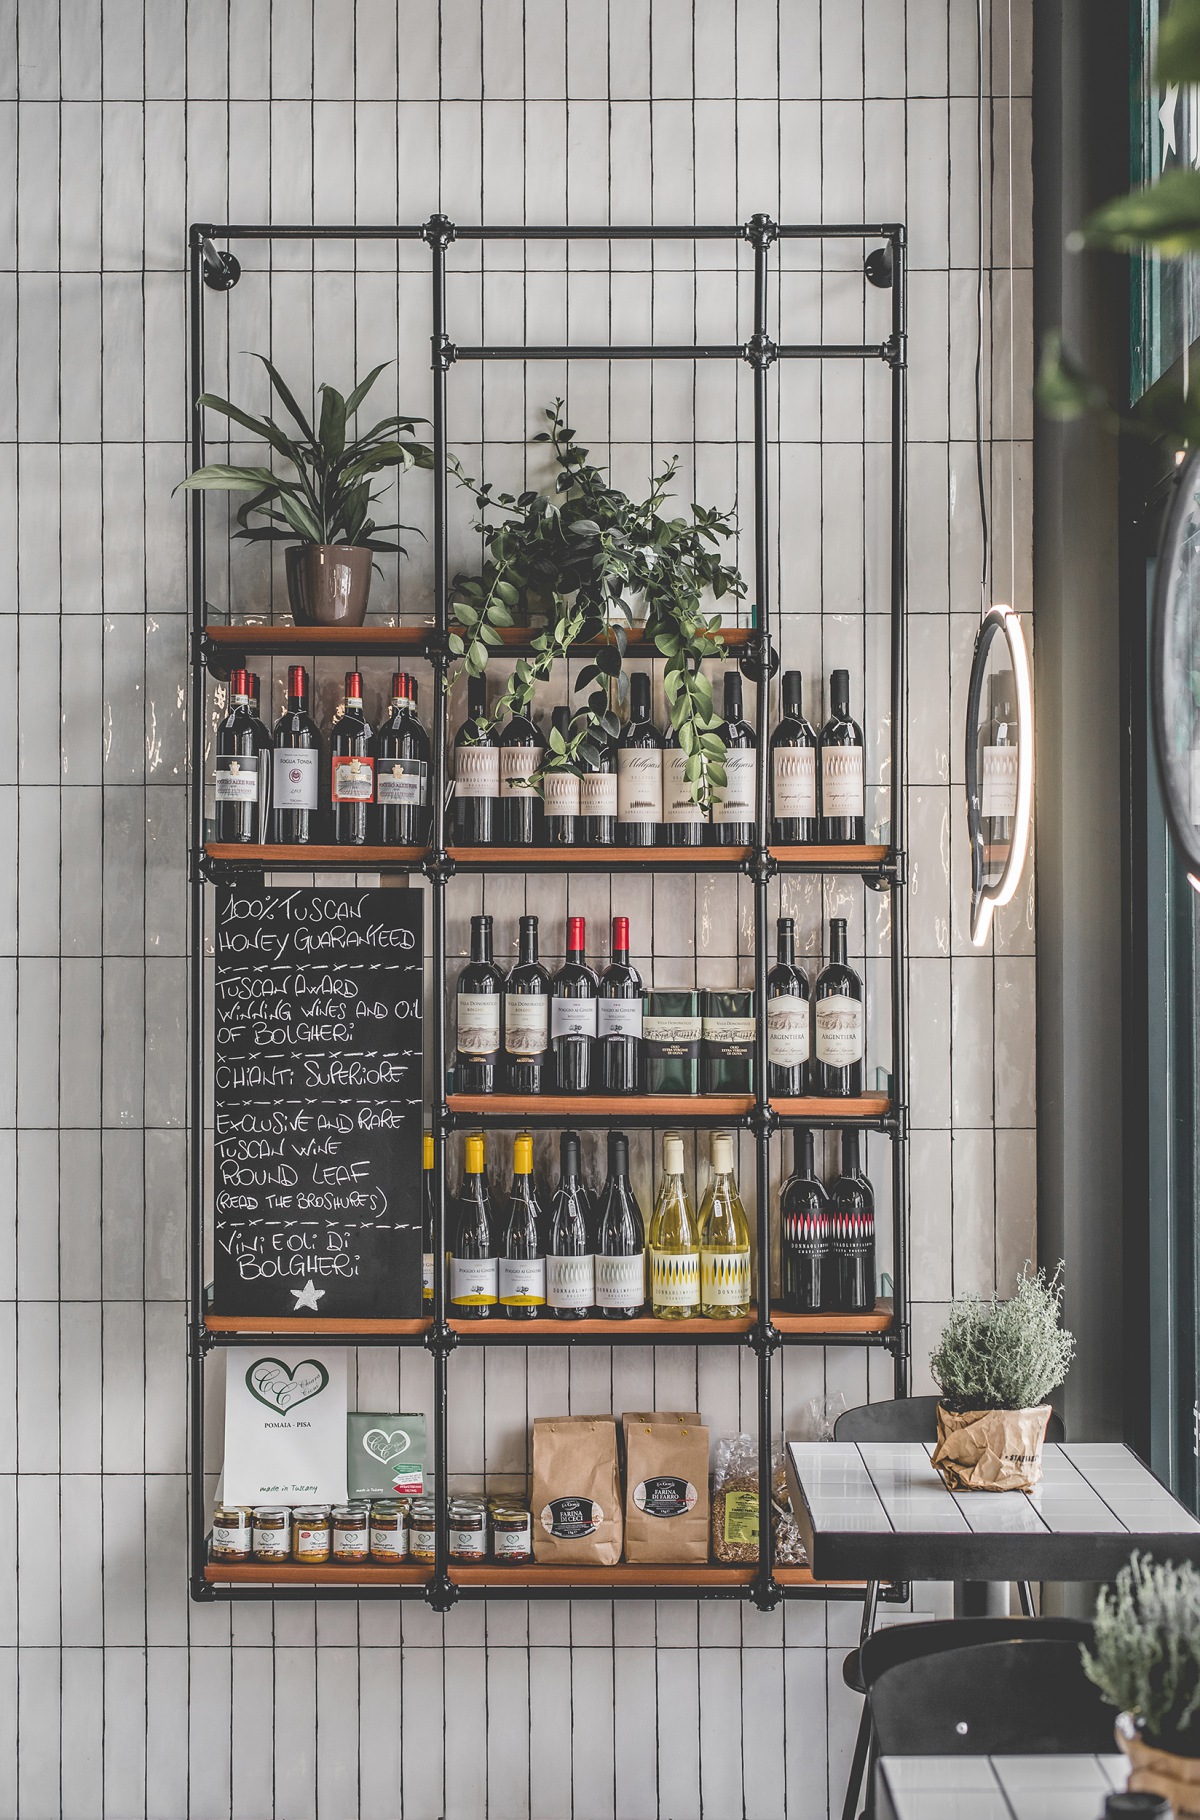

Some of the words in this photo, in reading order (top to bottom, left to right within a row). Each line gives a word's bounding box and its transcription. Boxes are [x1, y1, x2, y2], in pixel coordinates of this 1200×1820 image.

[221, 894, 278, 925] 100%
[278, 890, 369, 922] TUSCAN
[218, 927, 289, 960] HONEY
[215, 975, 292, 999] TUSCAN
[294, 974, 359, 998] AWARD
[356, 1000, 388, 1019] AND
[217, 1026, 246, 1043] OF
[318, 1113, 354, 1134] AND
[358, 1107, 405, 1131] RARE
[214, 1137, 285, 1161] TUSCAN
[220, 1159, 299, 1186] ROUND
[312, 1160, 371, 1185] LEAF
[266, 1194, 293, 1209] THE
[259, 1484, 280, 1493] made
[281, 1484, 289, 1492] in
[291, 1484, 318, 1494] Tuscany
